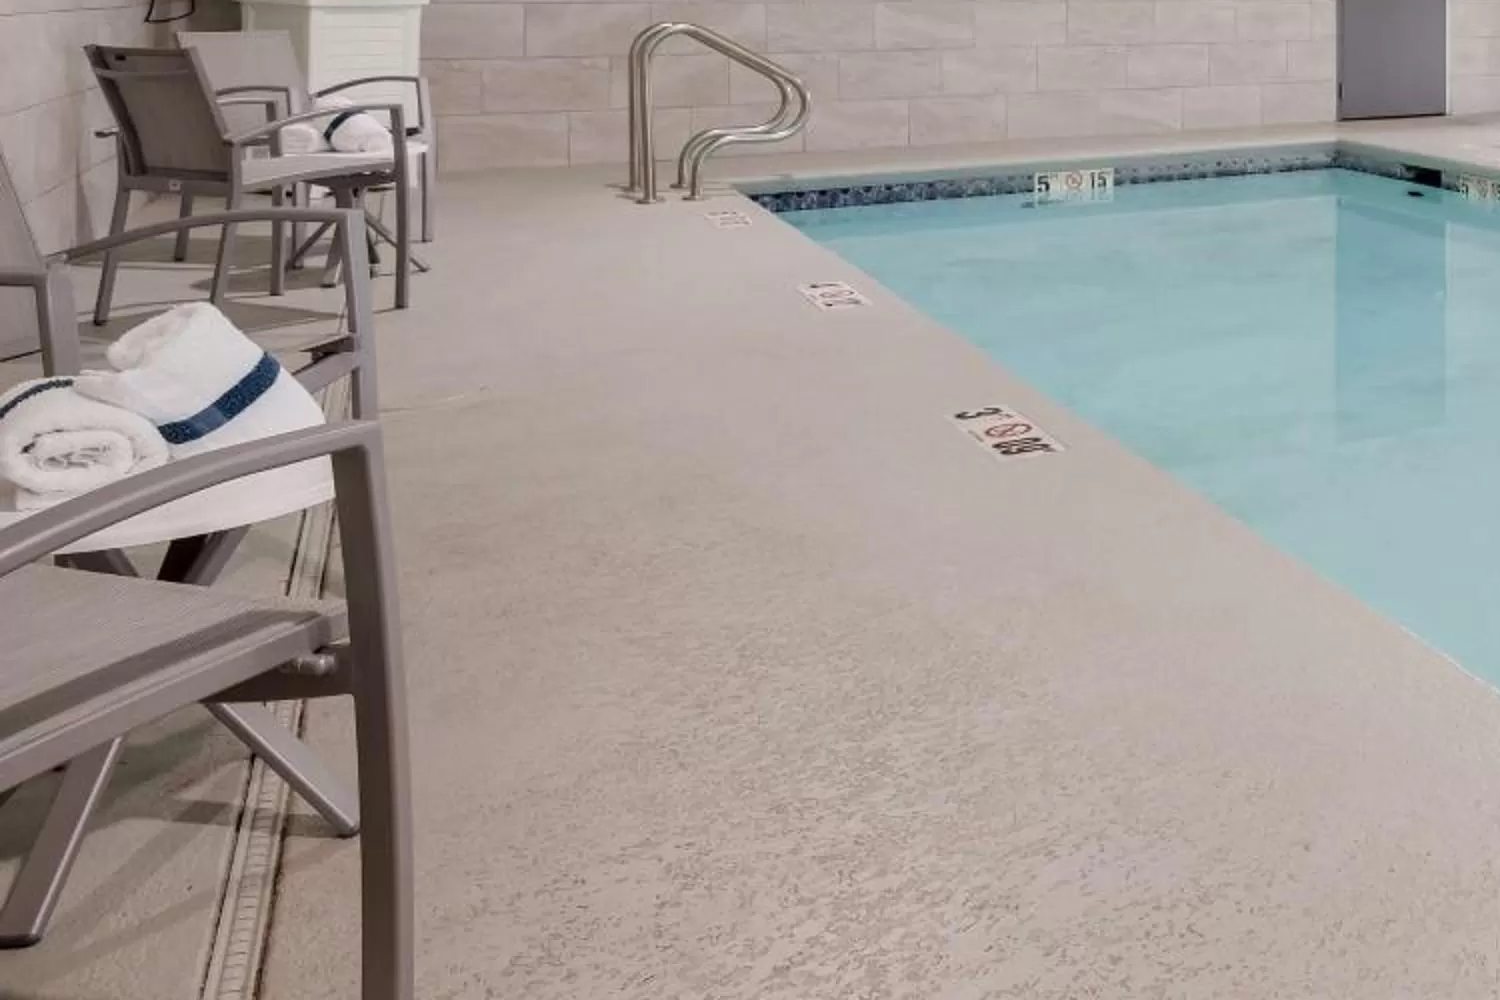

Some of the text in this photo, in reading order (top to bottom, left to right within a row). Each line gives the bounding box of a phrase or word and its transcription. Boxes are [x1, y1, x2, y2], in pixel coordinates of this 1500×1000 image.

[1037, 175, 1050, 193] 5
[1089, 171, 1107, 190] 15
[954, 407, 1003, 419] 3
